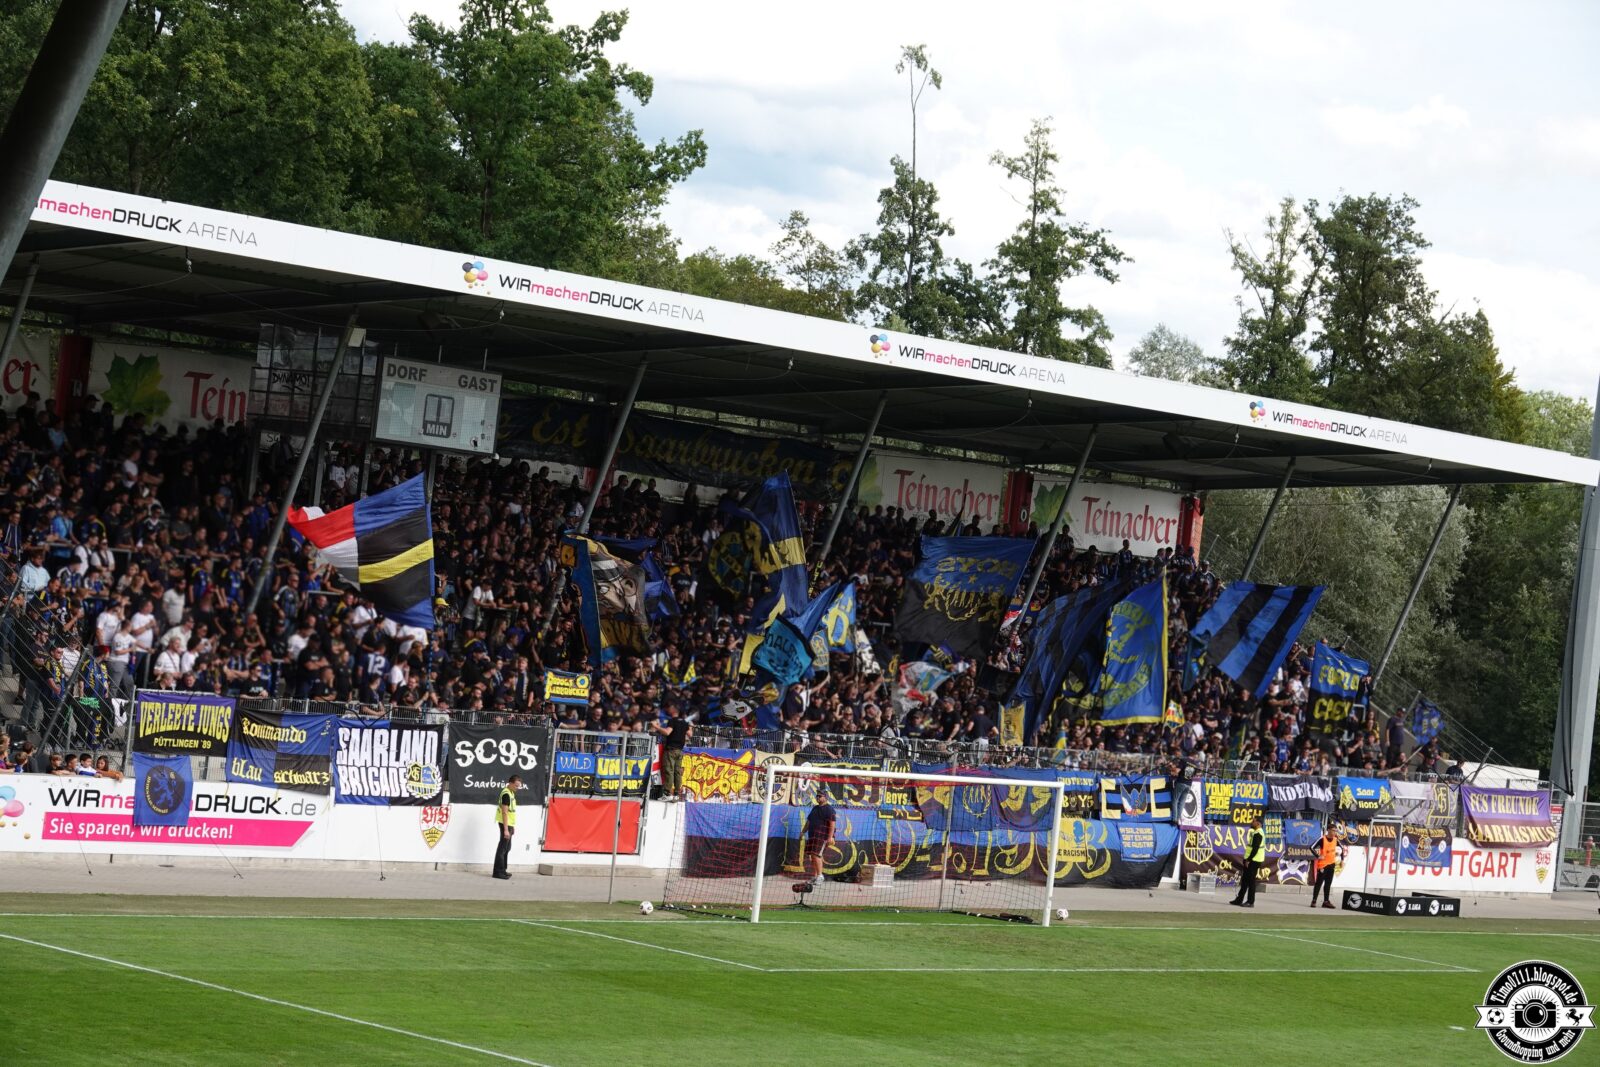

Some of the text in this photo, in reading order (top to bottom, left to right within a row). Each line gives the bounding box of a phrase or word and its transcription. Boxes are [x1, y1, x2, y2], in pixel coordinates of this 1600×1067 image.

[36, 198, 258, 247] machenDRUCK ARENA
[499, 274, 705, 323] WIRmachenDRUCK ARENA
[899, 345, 1066, 385] WIRmachenDRUCK ARENA
[387, 363, 498, 393] DORF GAST
[426, 423, 448, 437] MIN
[1272, 411, 1408, 444] WIRmachenDRUCK ARENA
[894, 469, 999, 521] Teinacher
[1083, 496, 1178, 544] Teinacher
[367, 655, 386, 676] 12
[139, 701, 231, 743] VERLEBTE JUNGS
[153, 737, 199, 749] PÜTTLINGEN
[337, 727, 438, 766] SAARLAND
[455, 738, 539, 770] SC95
[560, 755, 592, 771] WILD
[338, 765, 409, 798] BRIGADE
[558, 774, 590, 789] CATS
[1205, 782, 1233, 797] YOUNG
[1235, 782, 1264, 799] FORZA
[886, 792, 908, 805] BOYS
[1209, 796, 1231, 809] SIDE
[1356, 788, 1375, 797] Saar
[1358, 802, 1378, 810] lions
[1470, 793, 1540, 816] FCS FREUNDE
[50, 818, 73, 835] Sie
[78, 821, 135, 838] sparen,
[1063, 849, 1087, 857] RACISM
